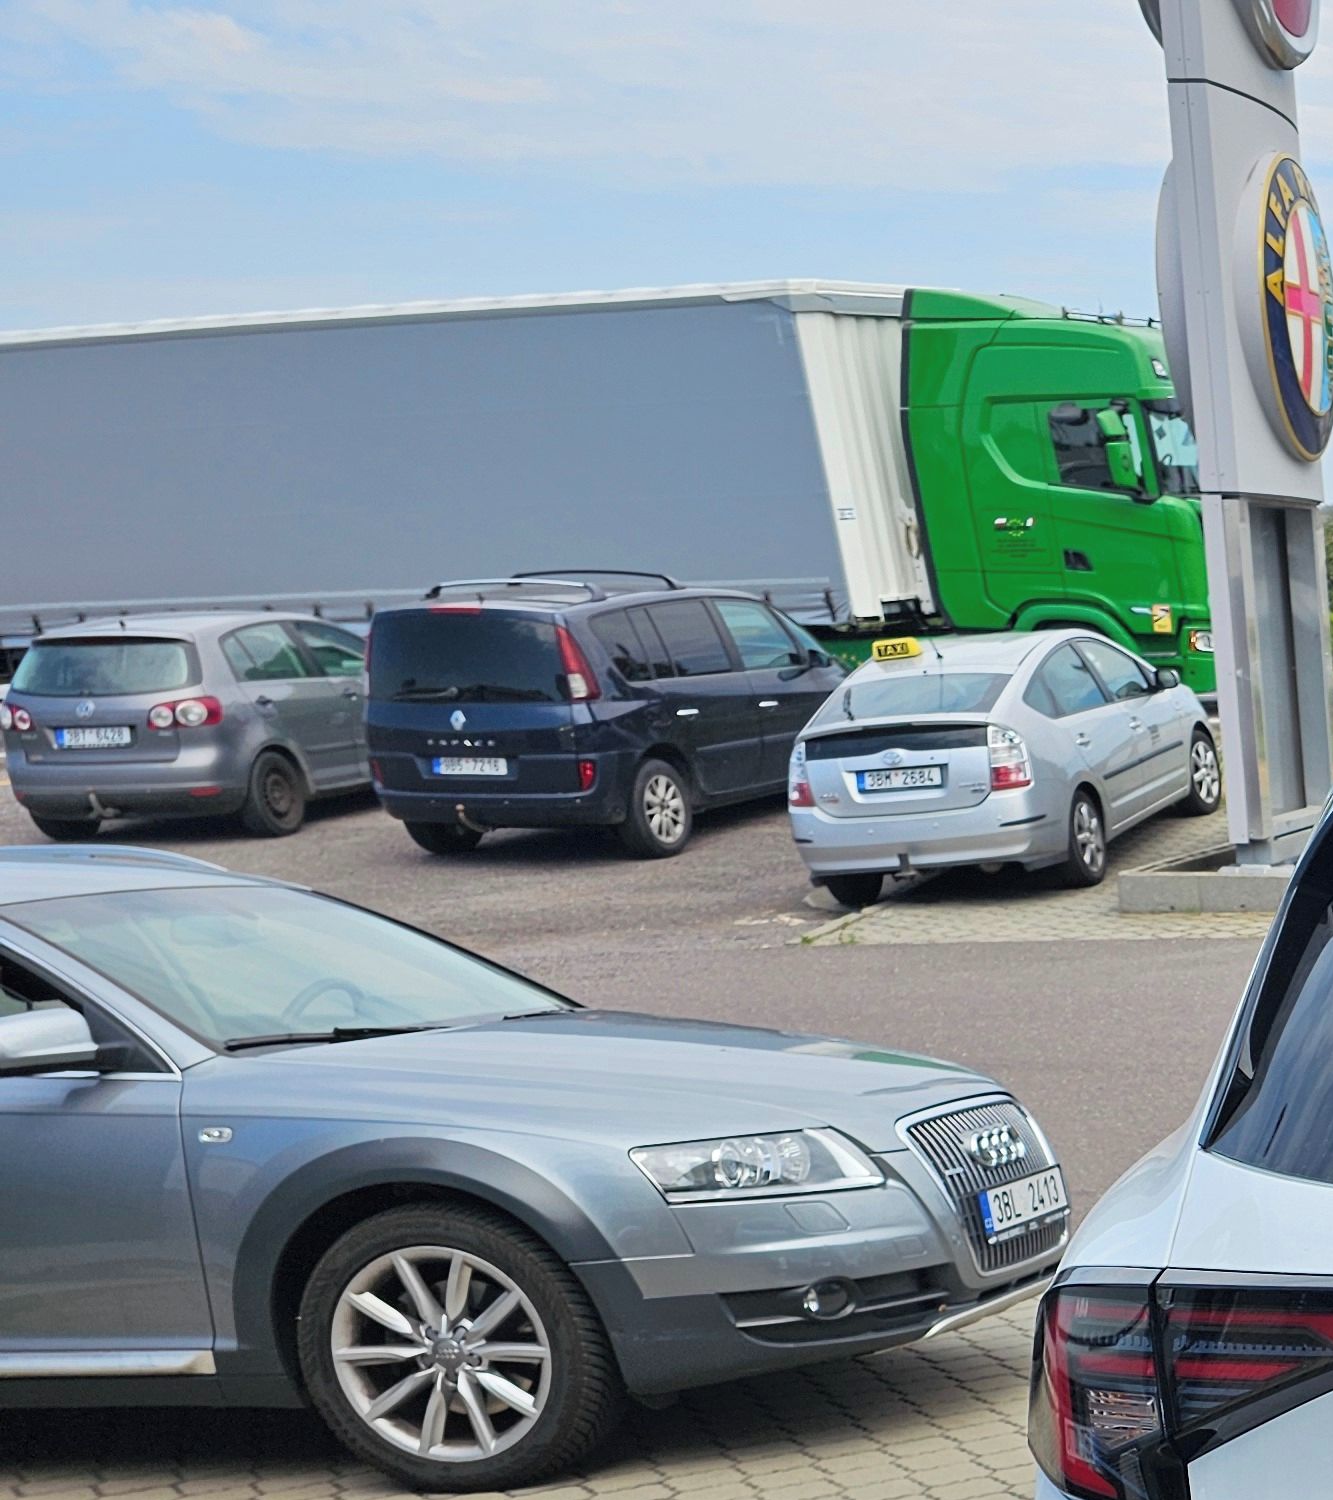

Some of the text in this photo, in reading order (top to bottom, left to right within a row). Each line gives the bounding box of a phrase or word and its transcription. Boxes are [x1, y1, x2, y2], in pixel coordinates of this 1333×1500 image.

[877, 642, 910, 658] TAXI
[993, 1175, 1060, 1224] 3BL 2413
